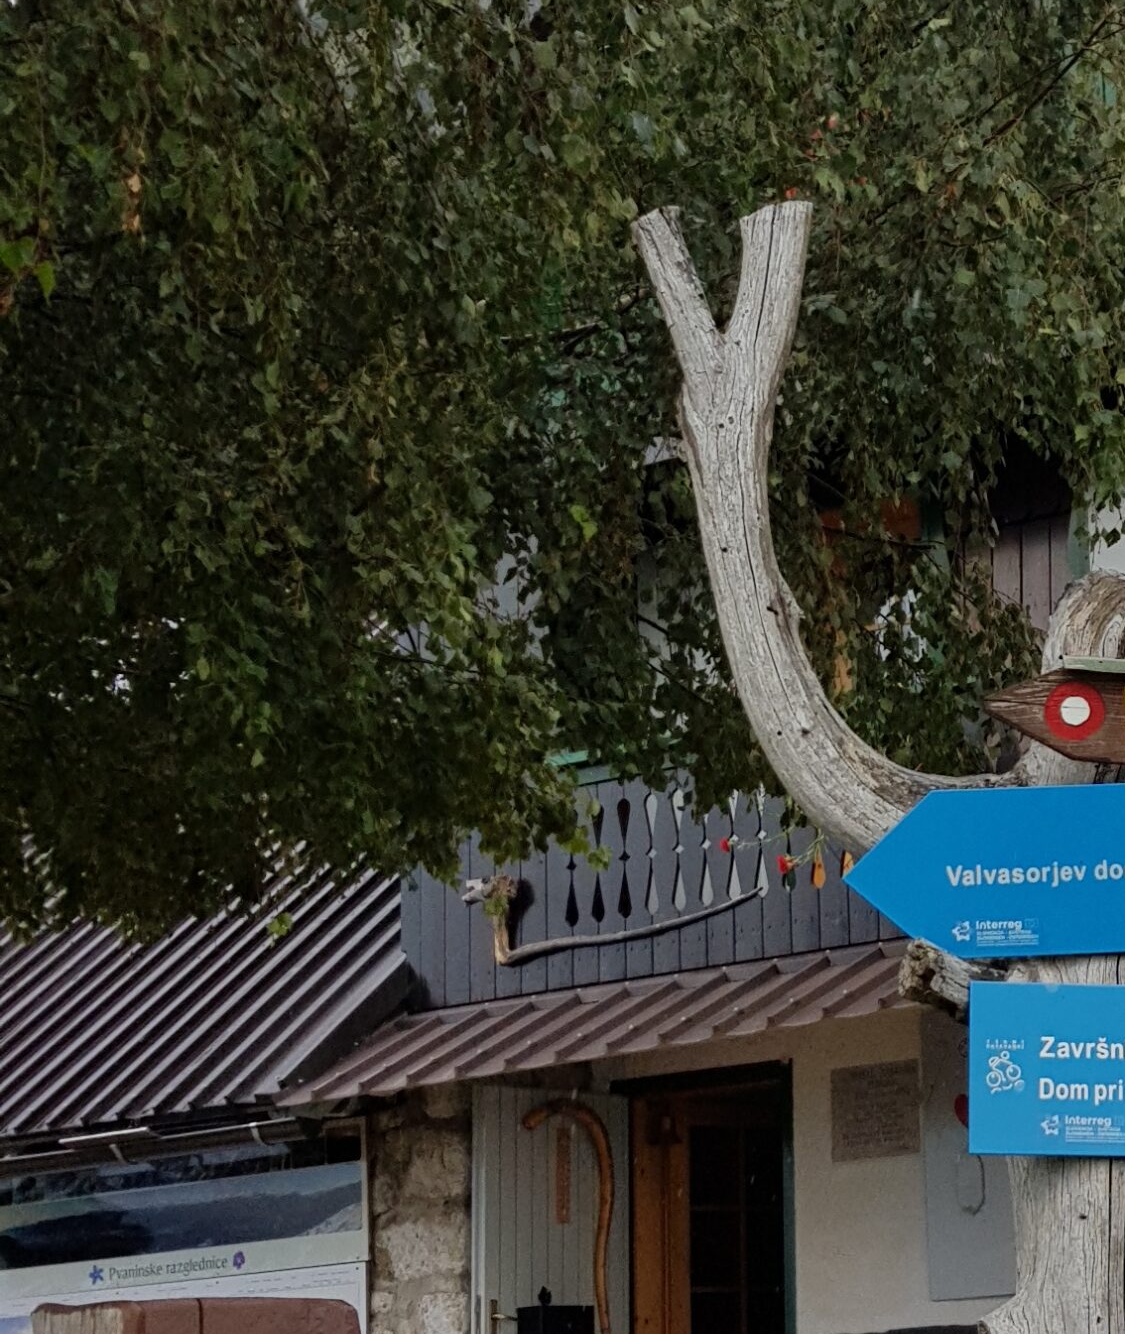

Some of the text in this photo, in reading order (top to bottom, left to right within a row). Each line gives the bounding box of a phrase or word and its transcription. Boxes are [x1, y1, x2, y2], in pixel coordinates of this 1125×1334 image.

[946, 861, 1087, 888] Valvasorjev
[975, 920, 1023, 932] Interreg
[1039, 1078, 1089, 1101] Dom
[1094, 1079, 1124, 1106] pri
[1064, 1115, 1112, 1126] Interreg
[165, 1255, 228, 1277] razglednice
